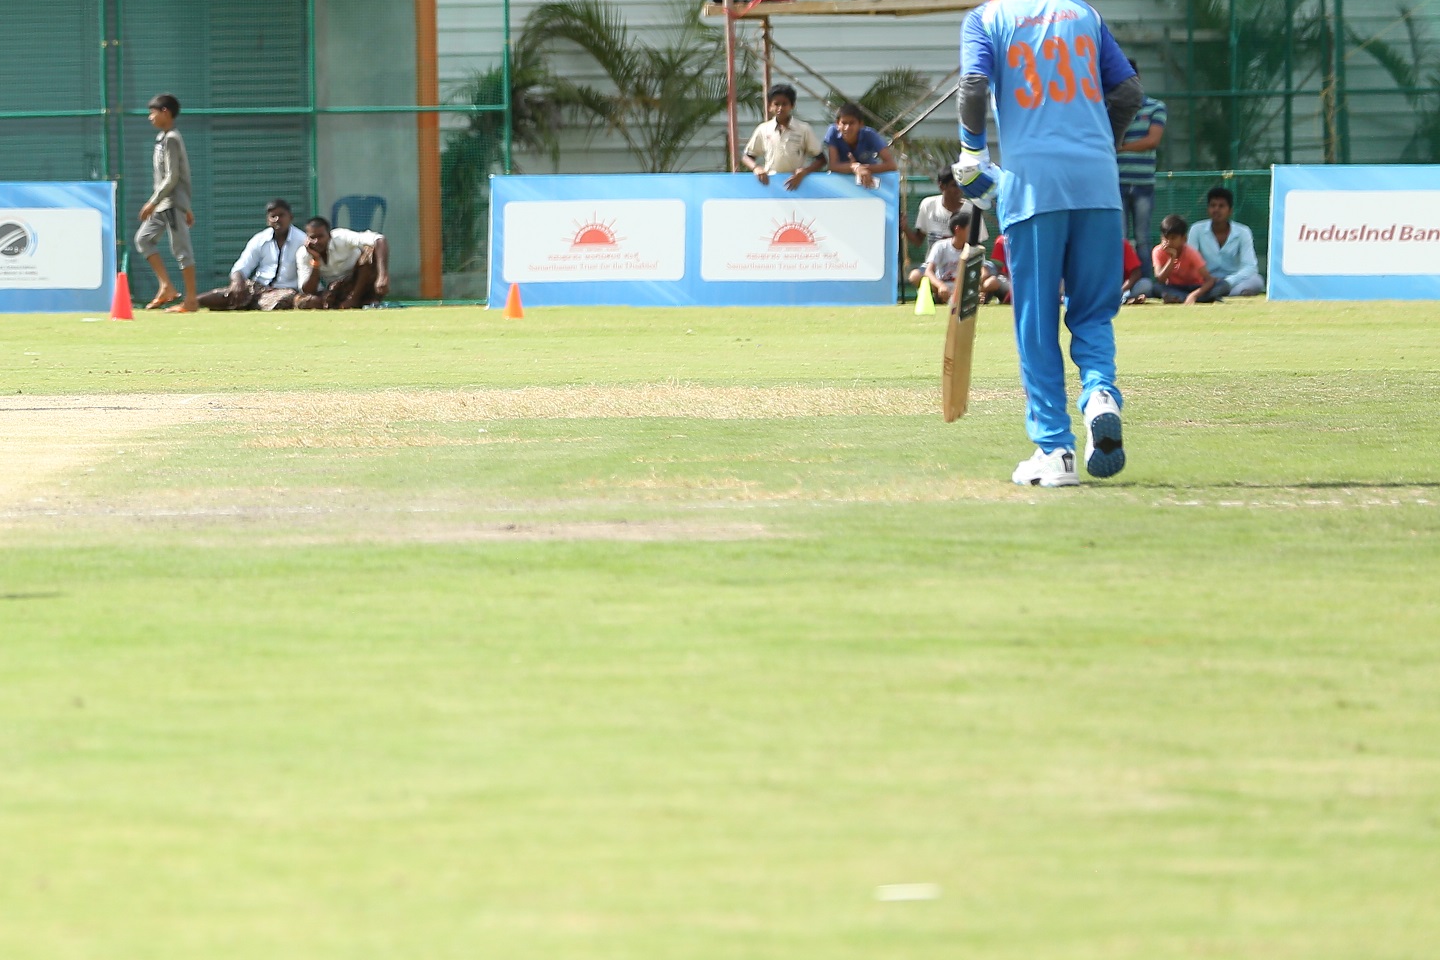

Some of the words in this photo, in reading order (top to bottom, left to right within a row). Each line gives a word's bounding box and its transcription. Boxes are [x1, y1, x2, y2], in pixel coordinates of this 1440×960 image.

[1006, 34, 1103, 110] 333
[1298, 223, 1397, 242] IndusInd
[1399, 225, 1440, 242] Ban
